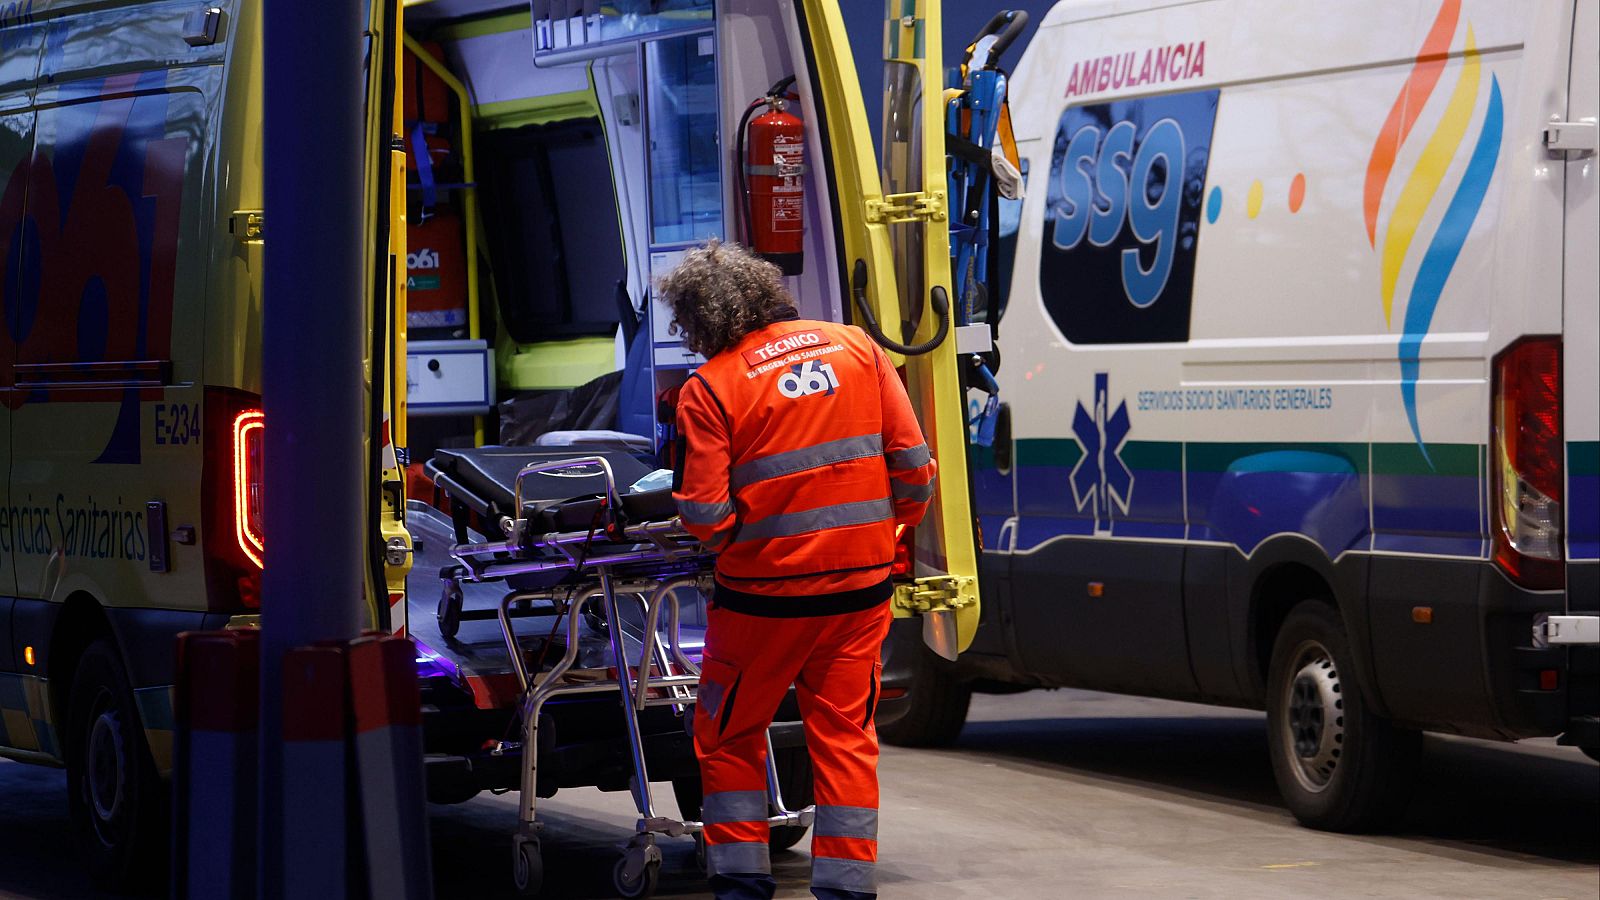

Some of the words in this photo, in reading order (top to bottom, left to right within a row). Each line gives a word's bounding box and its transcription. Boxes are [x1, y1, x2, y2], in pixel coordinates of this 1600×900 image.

[1064, 41, 1206, 99] AMBULANCIA
[1053, 118, 1186, 309] ssg
[0, 72, 188, 409] 061
[407, 248, 439, 269] 061
[755, 333, 820, 360] TÉCNICO
[801, 344, 844, 360] SANITARIAS
[777, 361, 840, 399] 061
[1137, 391, 1183, 411] SERVICIOS
[1186, 390, 1214, 411] SOCIO
[1216, 390, 1271, 410] SANITARIOS
[1274, 388, 1332, 409] GENERALES
[155, 403, 200, 445] E-234
[0, 494, 52, 556] encias
[56, 493, 145, 561] Sanitarias
